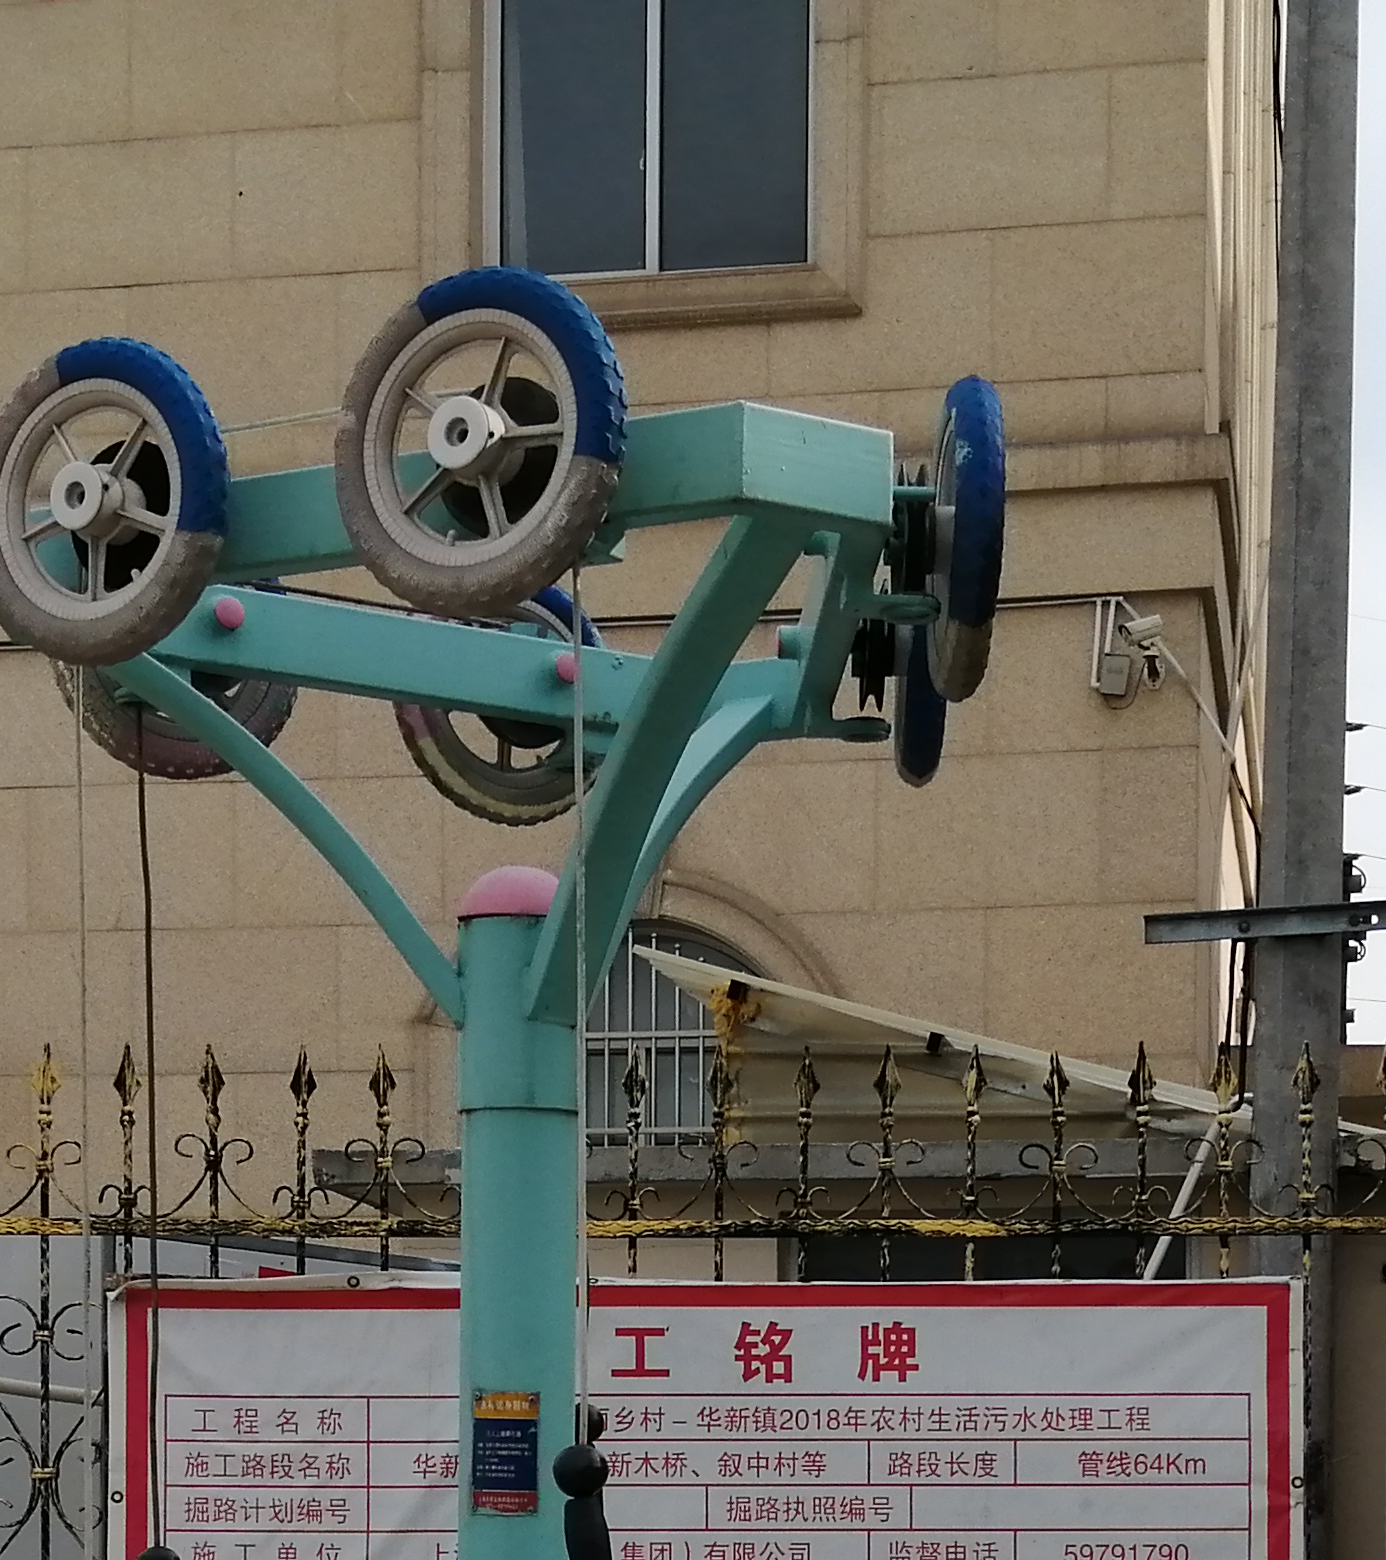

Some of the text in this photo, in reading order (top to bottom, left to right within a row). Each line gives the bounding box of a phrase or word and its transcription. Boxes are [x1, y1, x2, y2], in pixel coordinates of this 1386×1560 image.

[191, 1406, 1151, 1435] 工程名称 乡村-华新镇2018年农村生活污水处理工程
[185, 1452, 351, 1480] 施工路段名称
[888, 1451, 998, 1478] 路段长度
[1078, 1451, 1206, 1478] 管线64Km
[185, 1496, 893, 1524] 掘路计划编号 掘路执照编号
